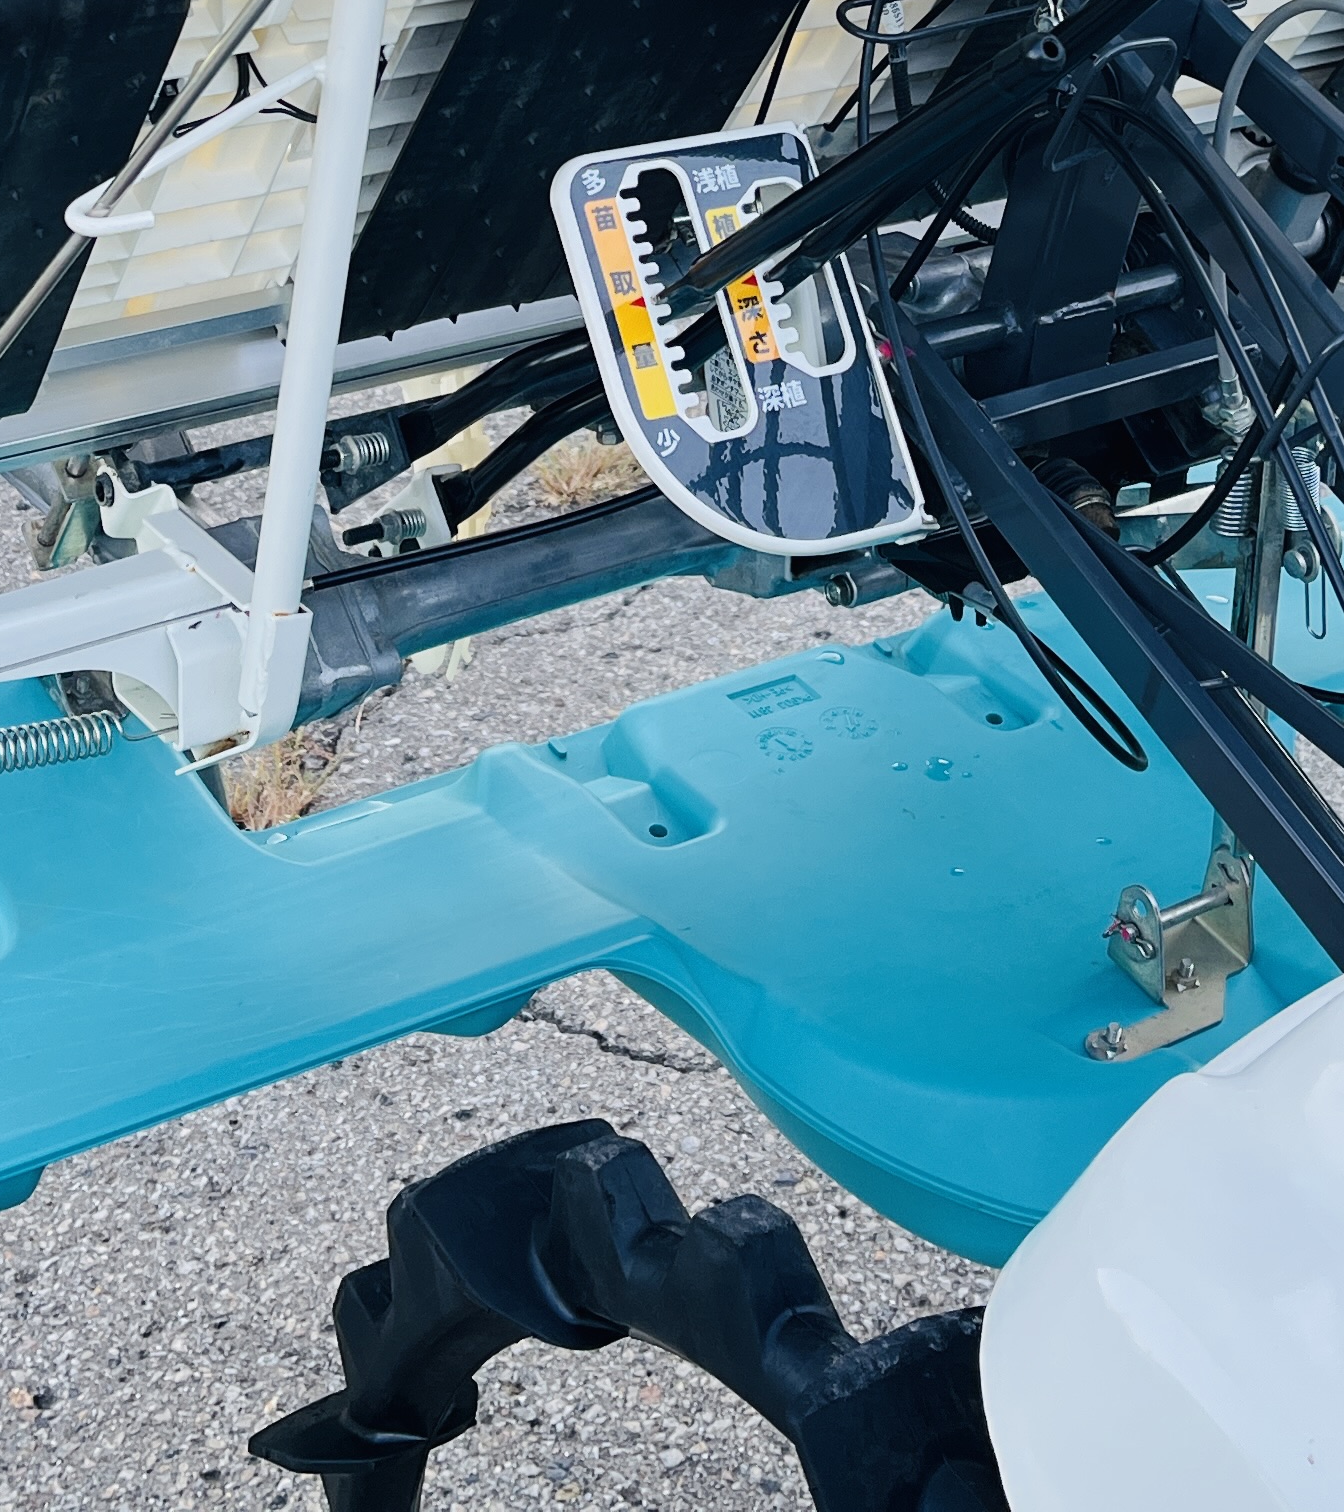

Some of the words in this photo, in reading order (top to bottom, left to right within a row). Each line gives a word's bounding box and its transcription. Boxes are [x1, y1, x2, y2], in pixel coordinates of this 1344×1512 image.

[581, 169, 606, 196] 多
[692, 164, 741, 194] 浅植
[757, 379, 808, 413] 深植
[656, 428, 681, 458] 少
